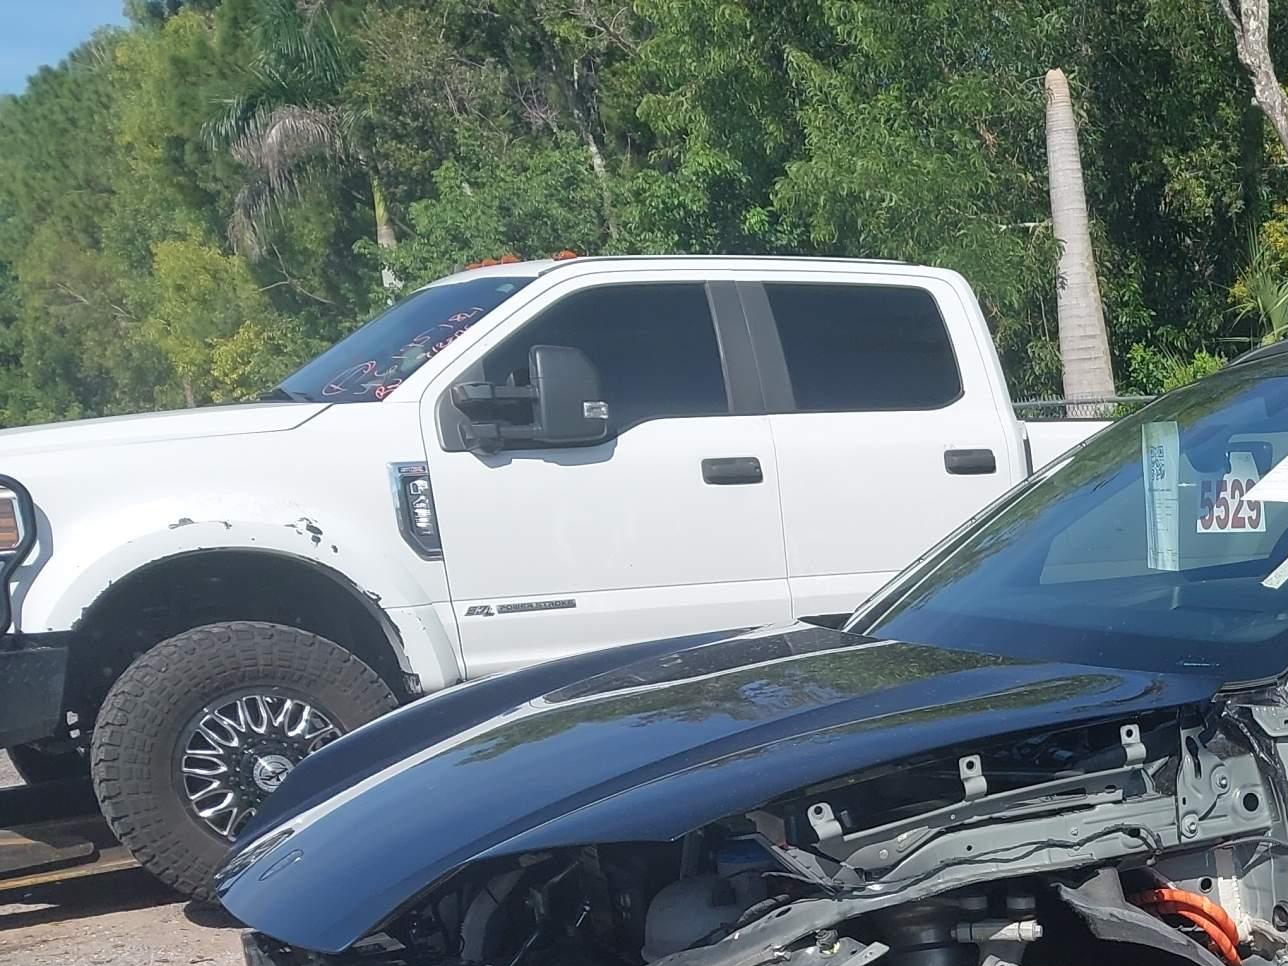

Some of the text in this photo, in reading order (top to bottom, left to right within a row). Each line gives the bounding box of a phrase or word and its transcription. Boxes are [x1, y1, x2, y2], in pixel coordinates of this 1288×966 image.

[1200, 478, 1261, 530] 5529
[497, 603, 533, 612] POWER
[534, 599, 576, 609] STROKE
